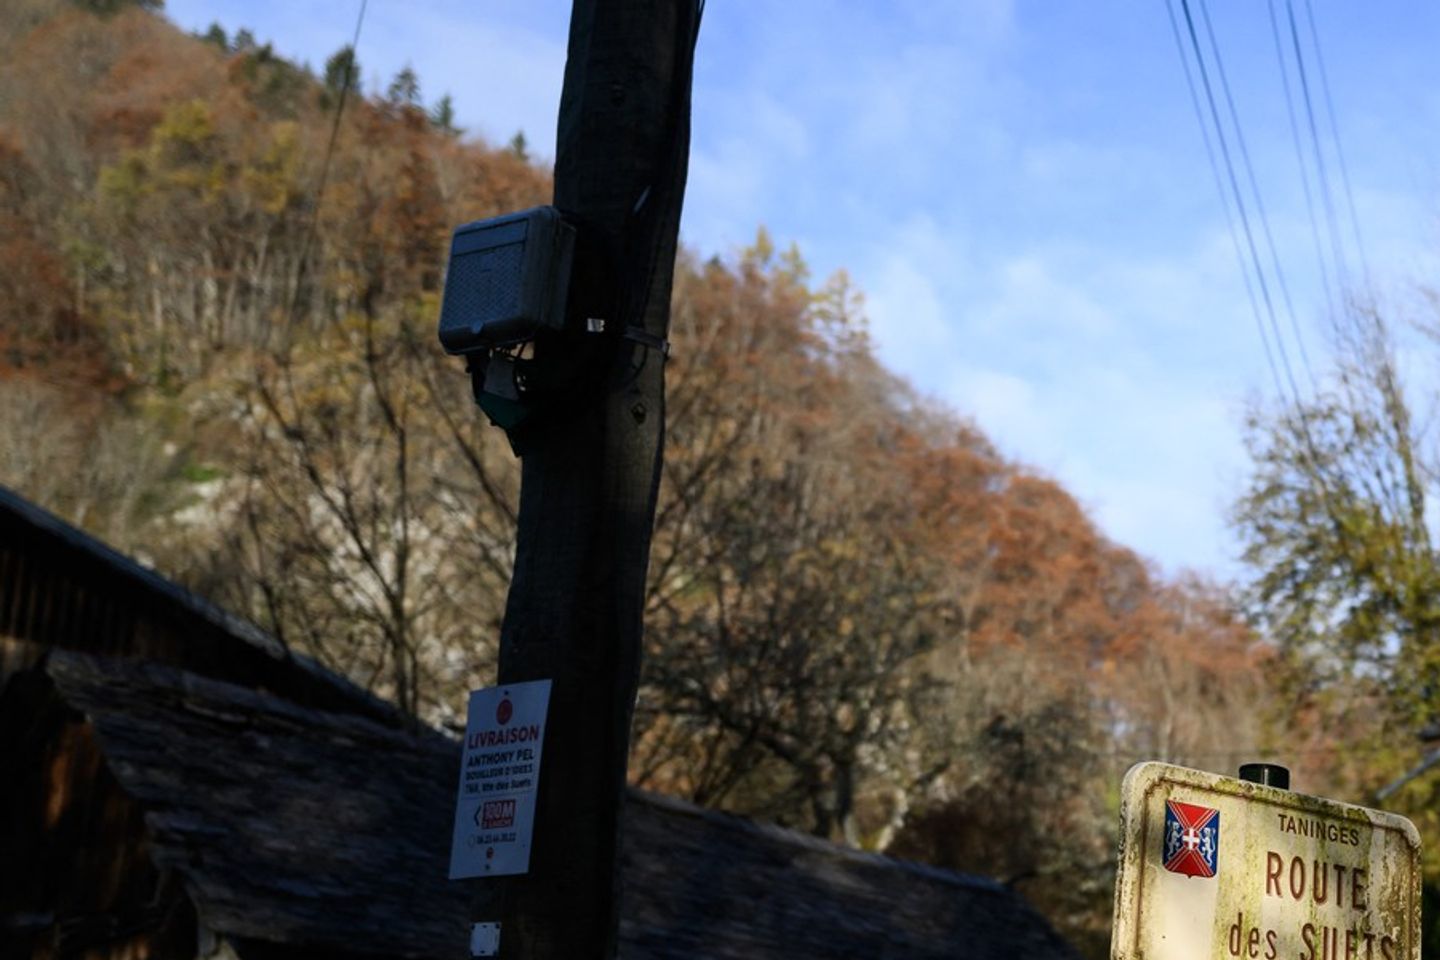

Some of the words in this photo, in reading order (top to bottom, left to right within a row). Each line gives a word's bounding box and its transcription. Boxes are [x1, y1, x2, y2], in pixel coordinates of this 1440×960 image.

[468, 725, 538, 749] LIVRAISON
[468, 751, 514, 766] ANTHONY
[1278, 814, 1359, 846] TANINGES
[1267, 851, 1368, 911] ROUTE
[1228, 912, 1278, 960] des
